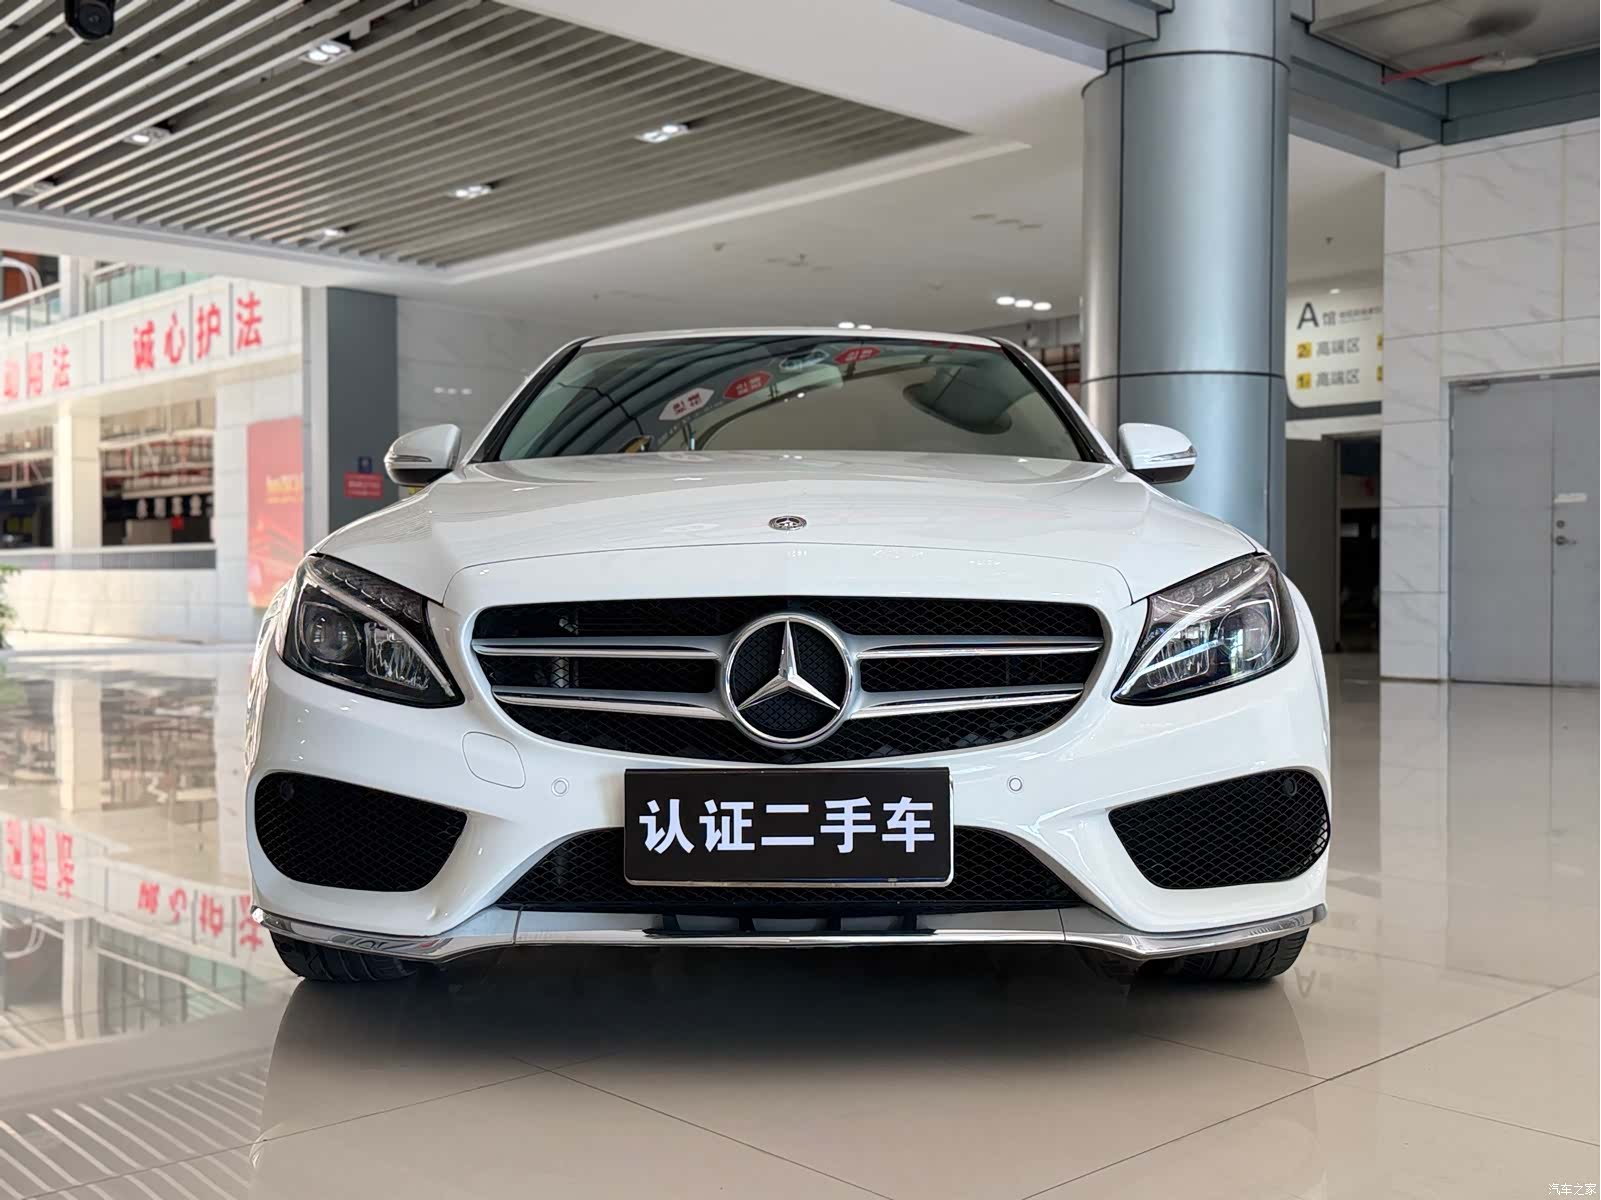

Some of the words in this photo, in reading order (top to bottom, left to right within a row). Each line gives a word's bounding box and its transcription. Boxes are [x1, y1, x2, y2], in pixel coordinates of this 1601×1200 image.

[133, 291, 263, 370] 诚心护法
[639, 796, 935, 854] 认证二手车
